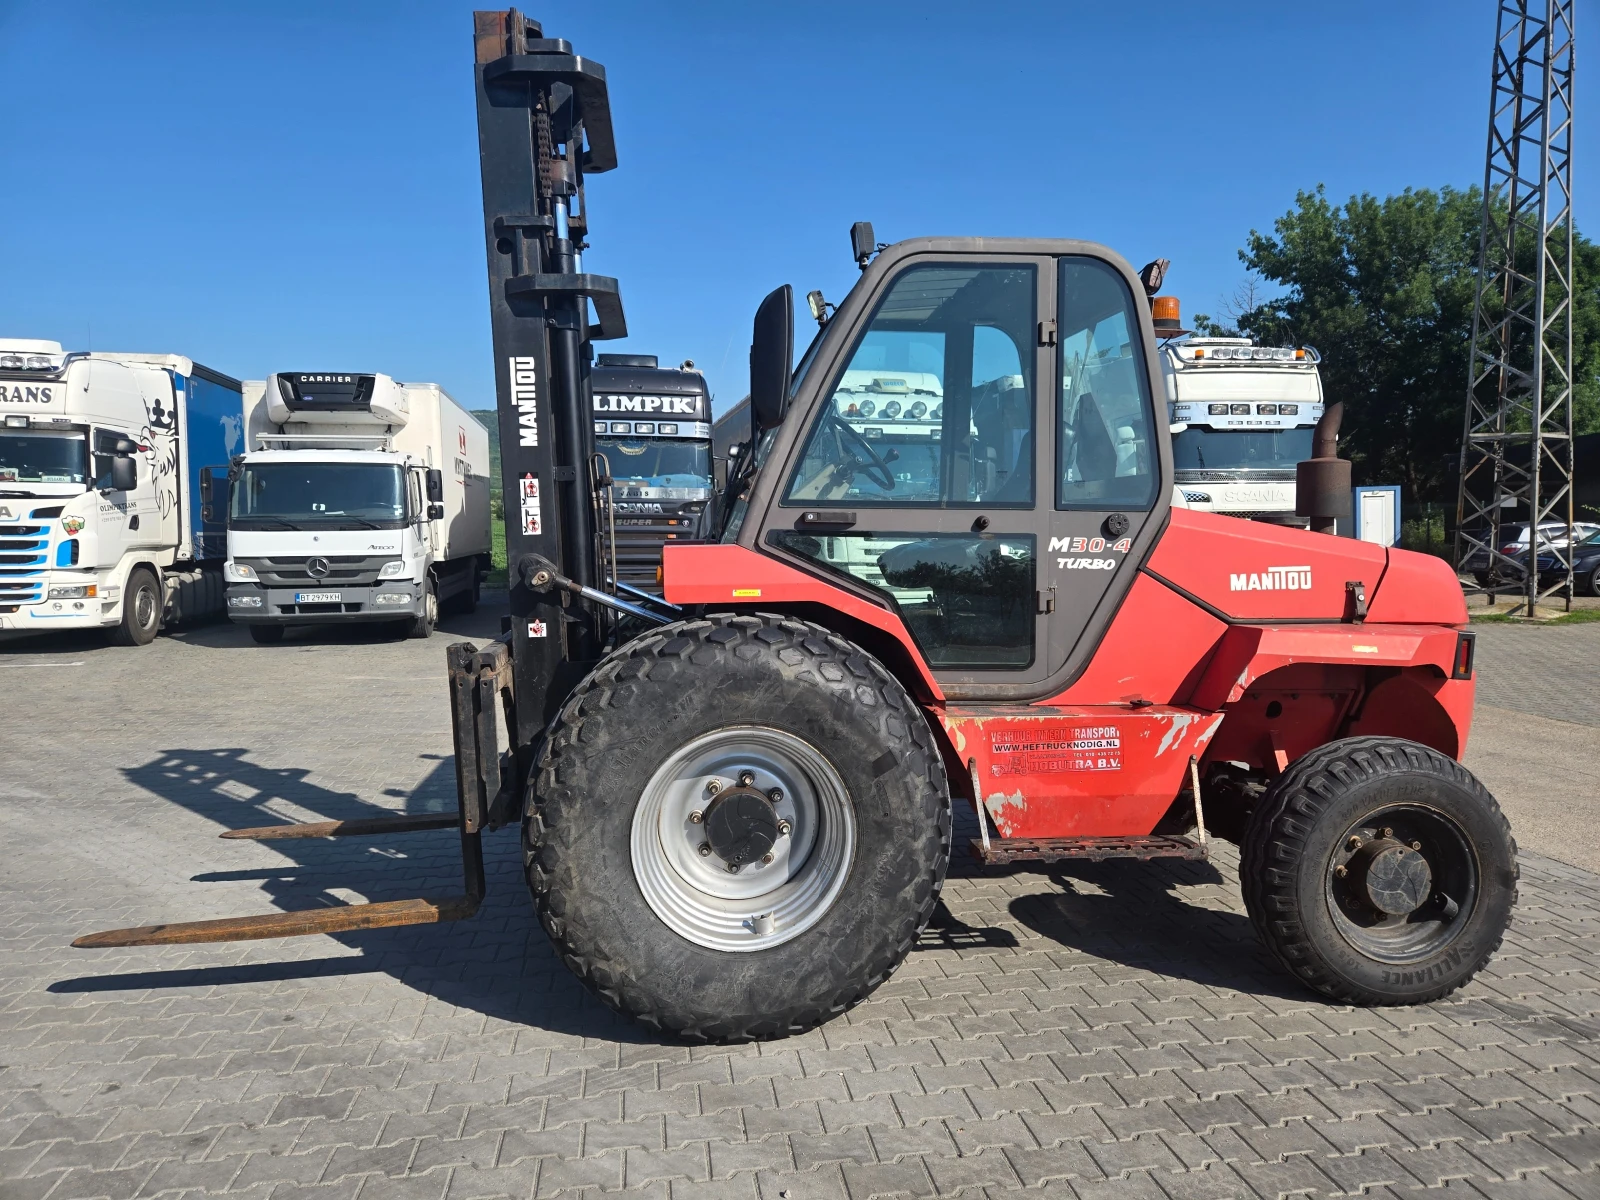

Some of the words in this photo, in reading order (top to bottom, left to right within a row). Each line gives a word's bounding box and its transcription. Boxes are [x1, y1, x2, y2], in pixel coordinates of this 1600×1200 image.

[301, 375, 351, 383] CARRIER
[509, 357, 538, 446] MANITOU
[1224, 489, 1289, 503] SCANIA
[605, 502, 664, 514] SCANIA
[1048, 536, 1132, 553] M30-4
[1057, 557, 1116, 570] TURBO
[1230, 565, 1312, 591] MANITOU
[994, 739, 1118, 752] WWW.HEFTRUCKNODIG.NL
